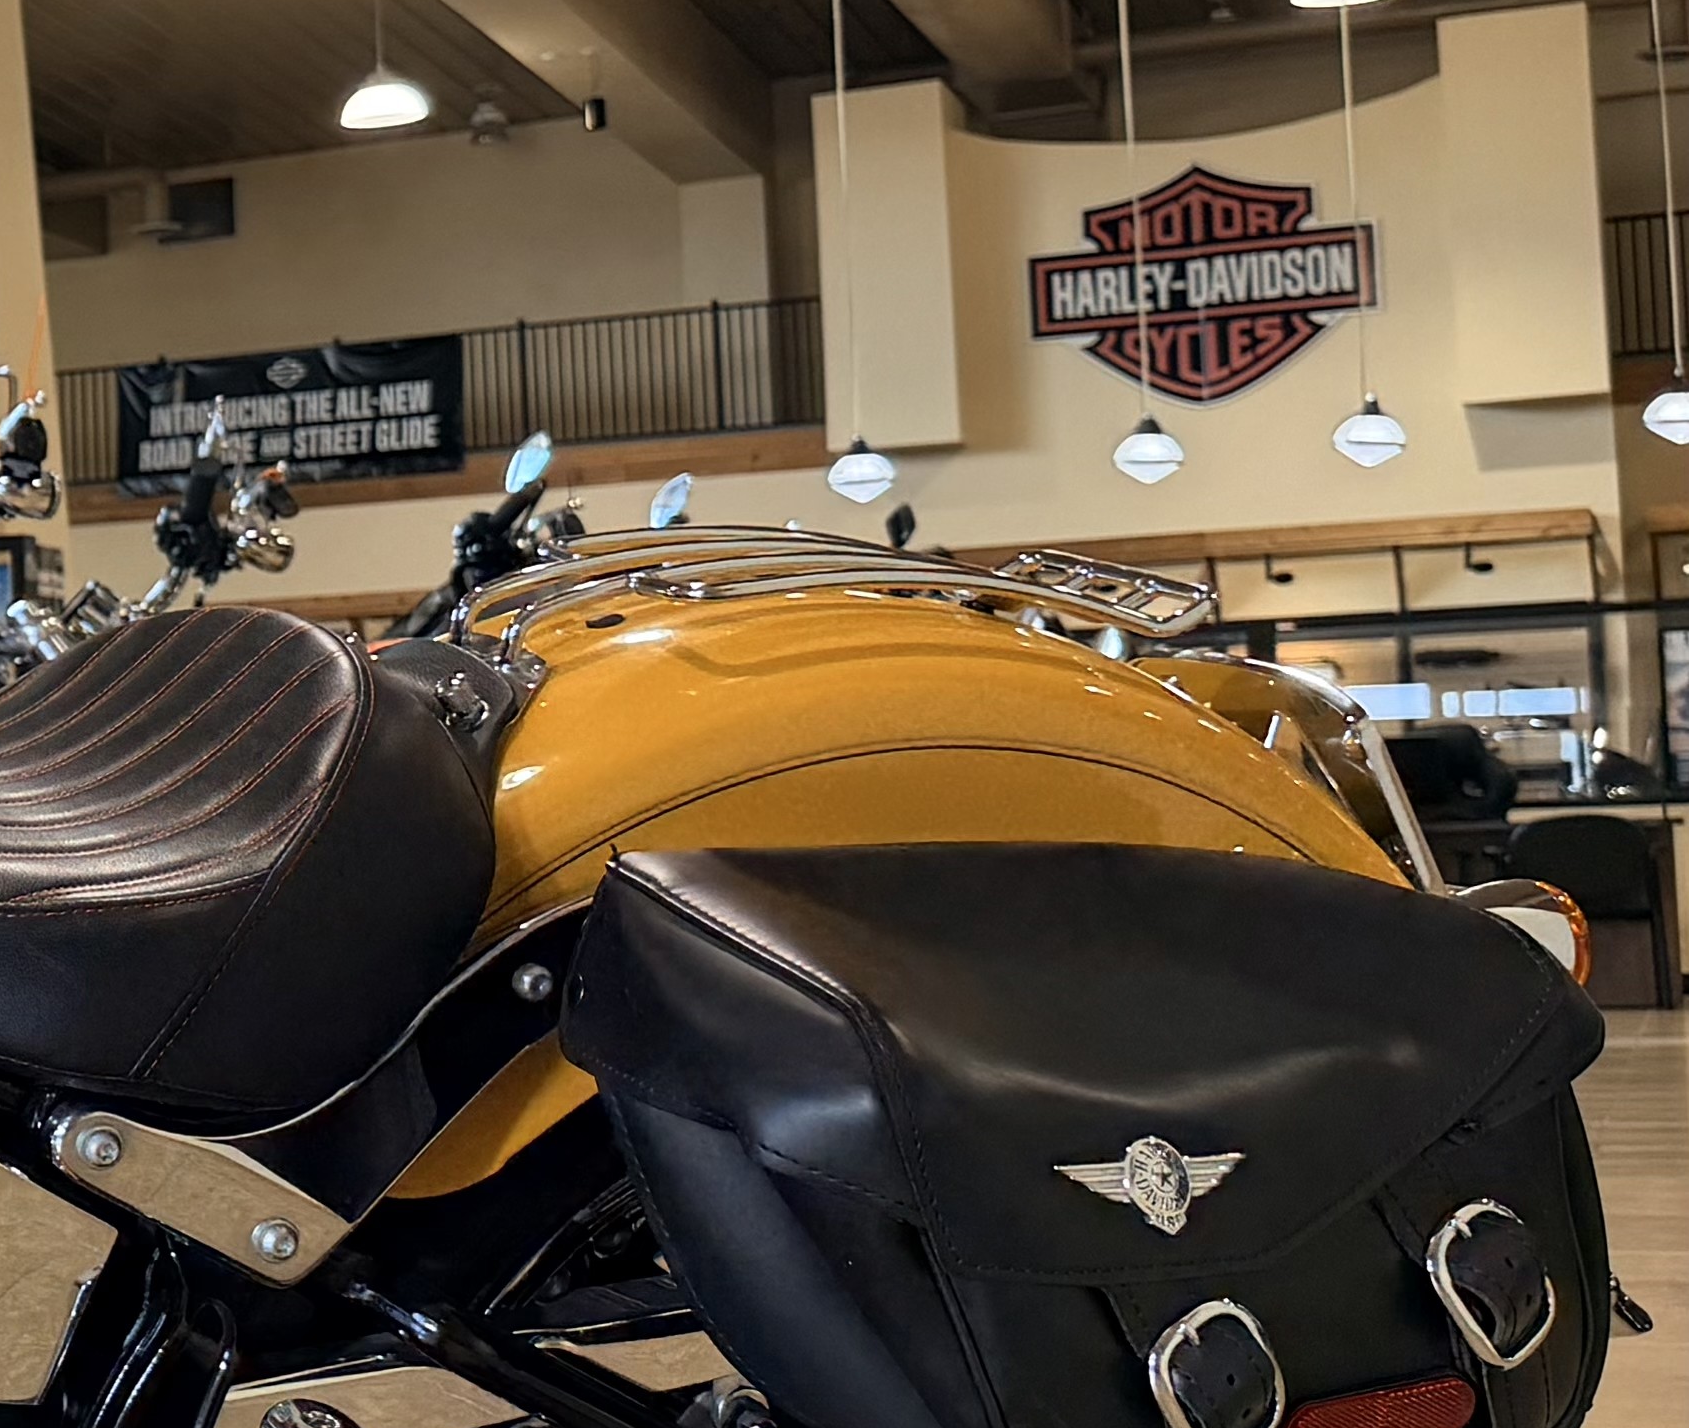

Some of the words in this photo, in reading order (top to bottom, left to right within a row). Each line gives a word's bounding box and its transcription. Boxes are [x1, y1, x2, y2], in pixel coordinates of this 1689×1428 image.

[1120, 192, 1280, 249] MOTOR
[1051, 243, 1353, 321] HARLEY-DAVIDSON
[1123, 314, 1288, 383] CYCLES
[293, 389, 334, 424] THE
[335, 379, 433, 421] ALL-NEW
[139, 437, 193, 472] ROAD
[293, 422, 372, 460] STREET
[375, 414, 441, 453] GLIDE
